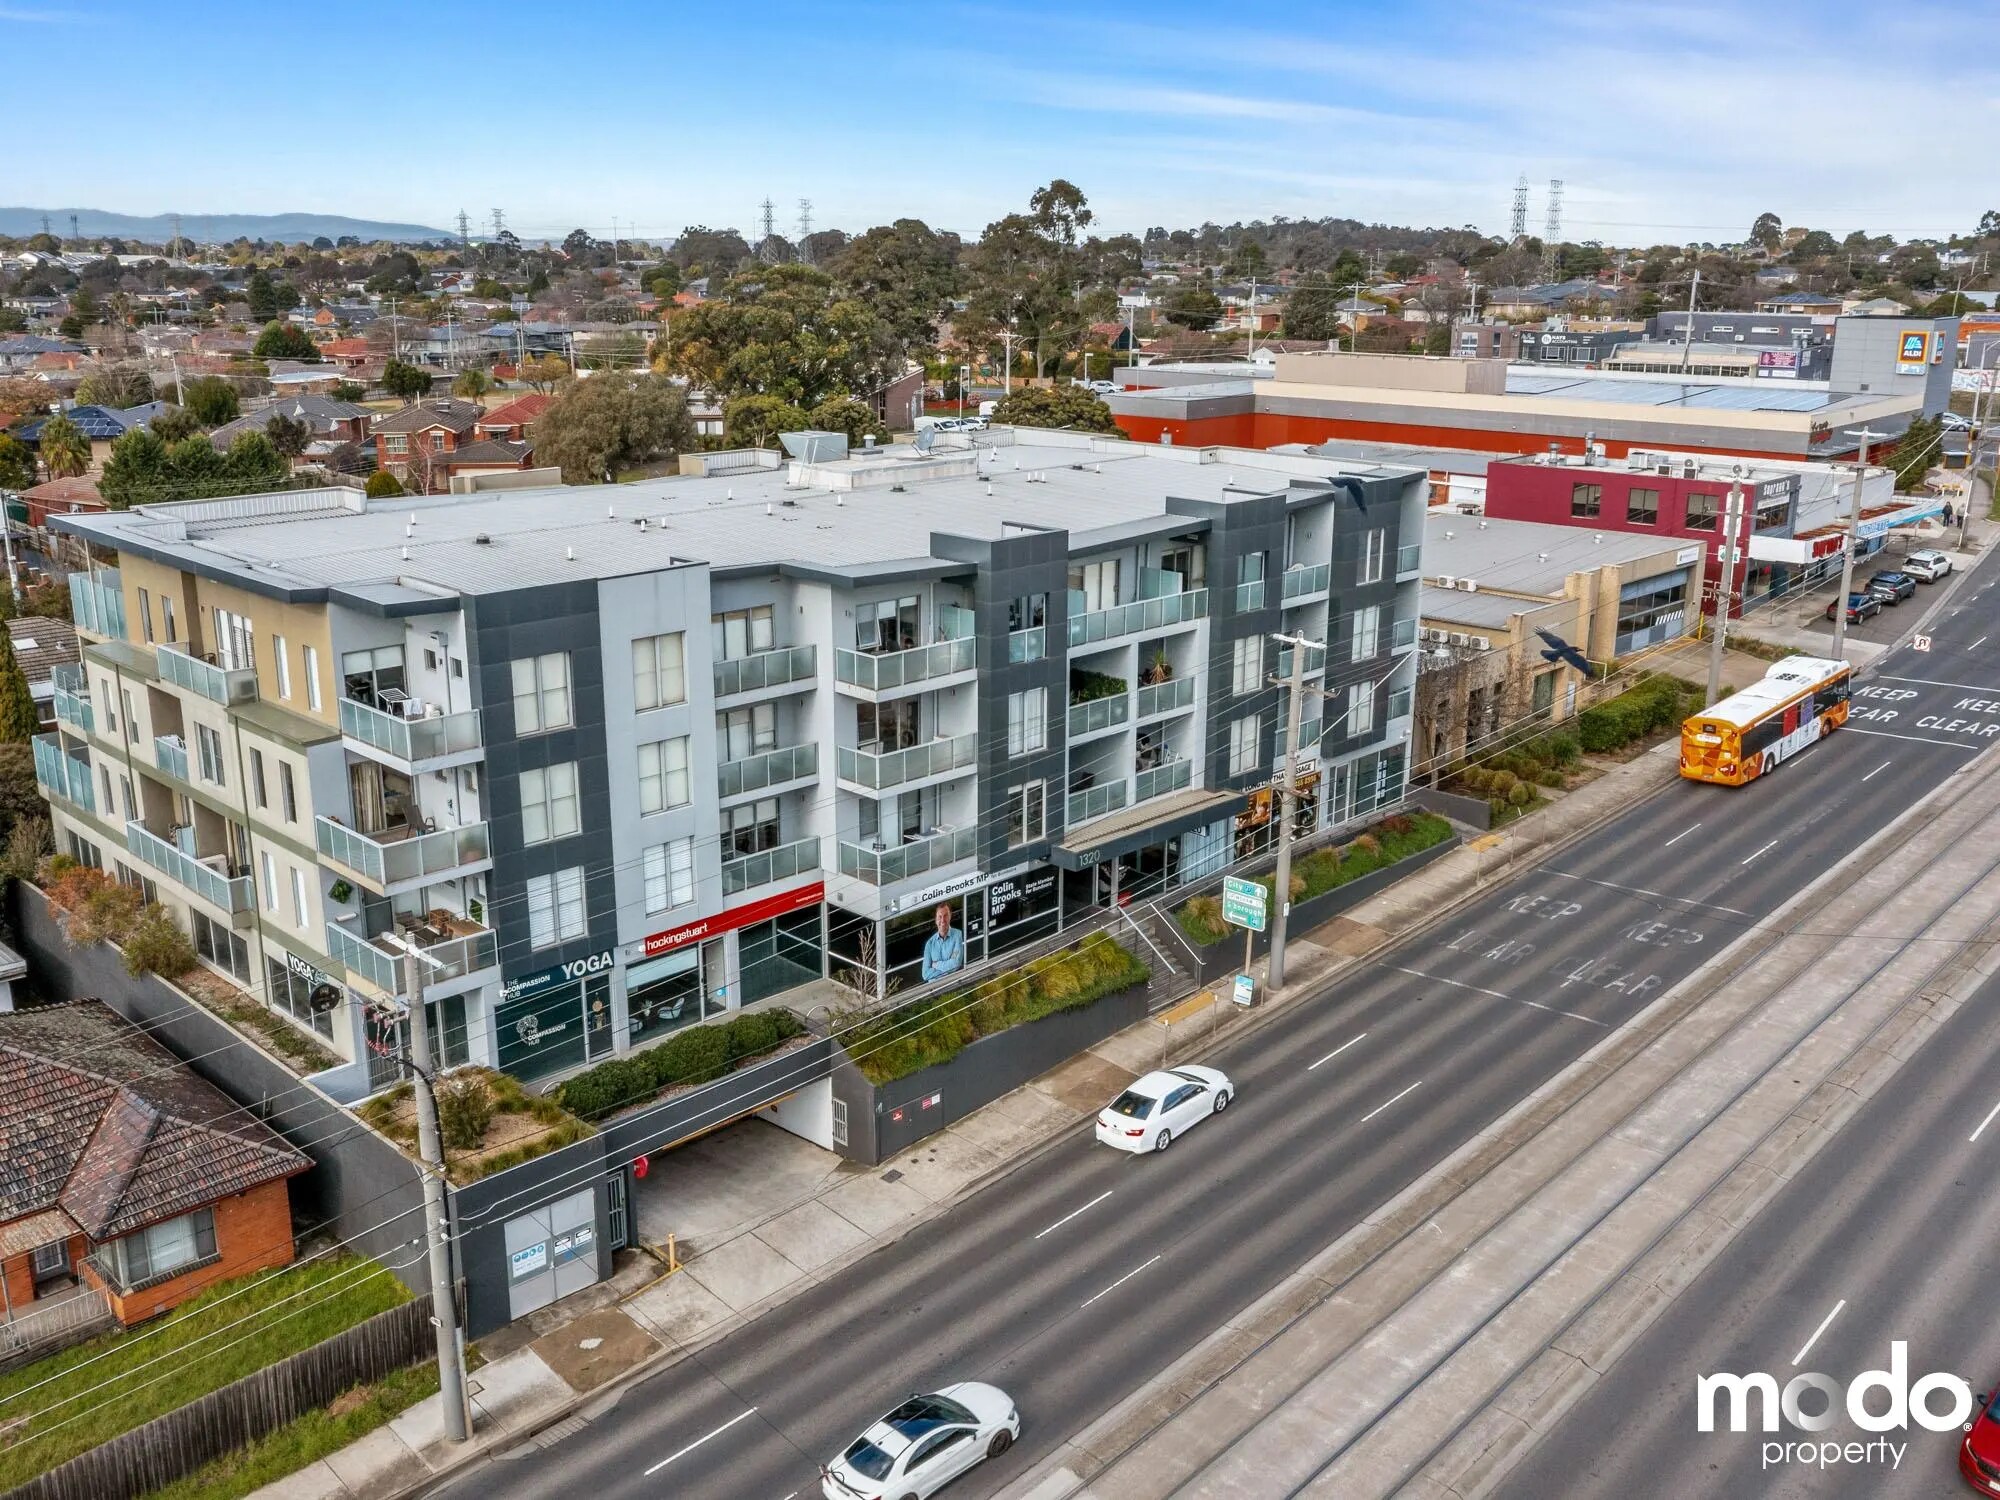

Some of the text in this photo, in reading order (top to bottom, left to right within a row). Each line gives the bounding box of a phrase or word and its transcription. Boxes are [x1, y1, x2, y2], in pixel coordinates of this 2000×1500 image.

[1854, 685, 1918, 701] KEEP
[1953, 698, 2000, 714] KEE
[1849, 706, 1899, 723] EAR
[1916, 716, 2000, 737] CLEAR
[1079, 849, 1100, 867] 1320
[922, 889, 944, 902] Colin
[945, 878, 975, 894] Brooks
[976, 873, 989, 883] MP
[991, 881, 1014, 896] Colin
[1025, 876, 1055, 890] State Member
[1228, 880, 1242, 891] City
[991, 889, 1022, 906] Brooks
[991, 903, 1006, 917] MP
[646, 922, 708, 951] hockingstuart
[288, 953, 314, 981] YOGA
[561, 951, 614, 980] YOGA
[507, 979, 518, 987] THE
[507, 974, 551, 994] COMPASSION
[507, 990, 521, 1000] HUB
[527, 1023, 566, 1041] COMPASSION
[528, 1027, 538, 1036] THE
[528, 1038, 540, 1047] HUB
